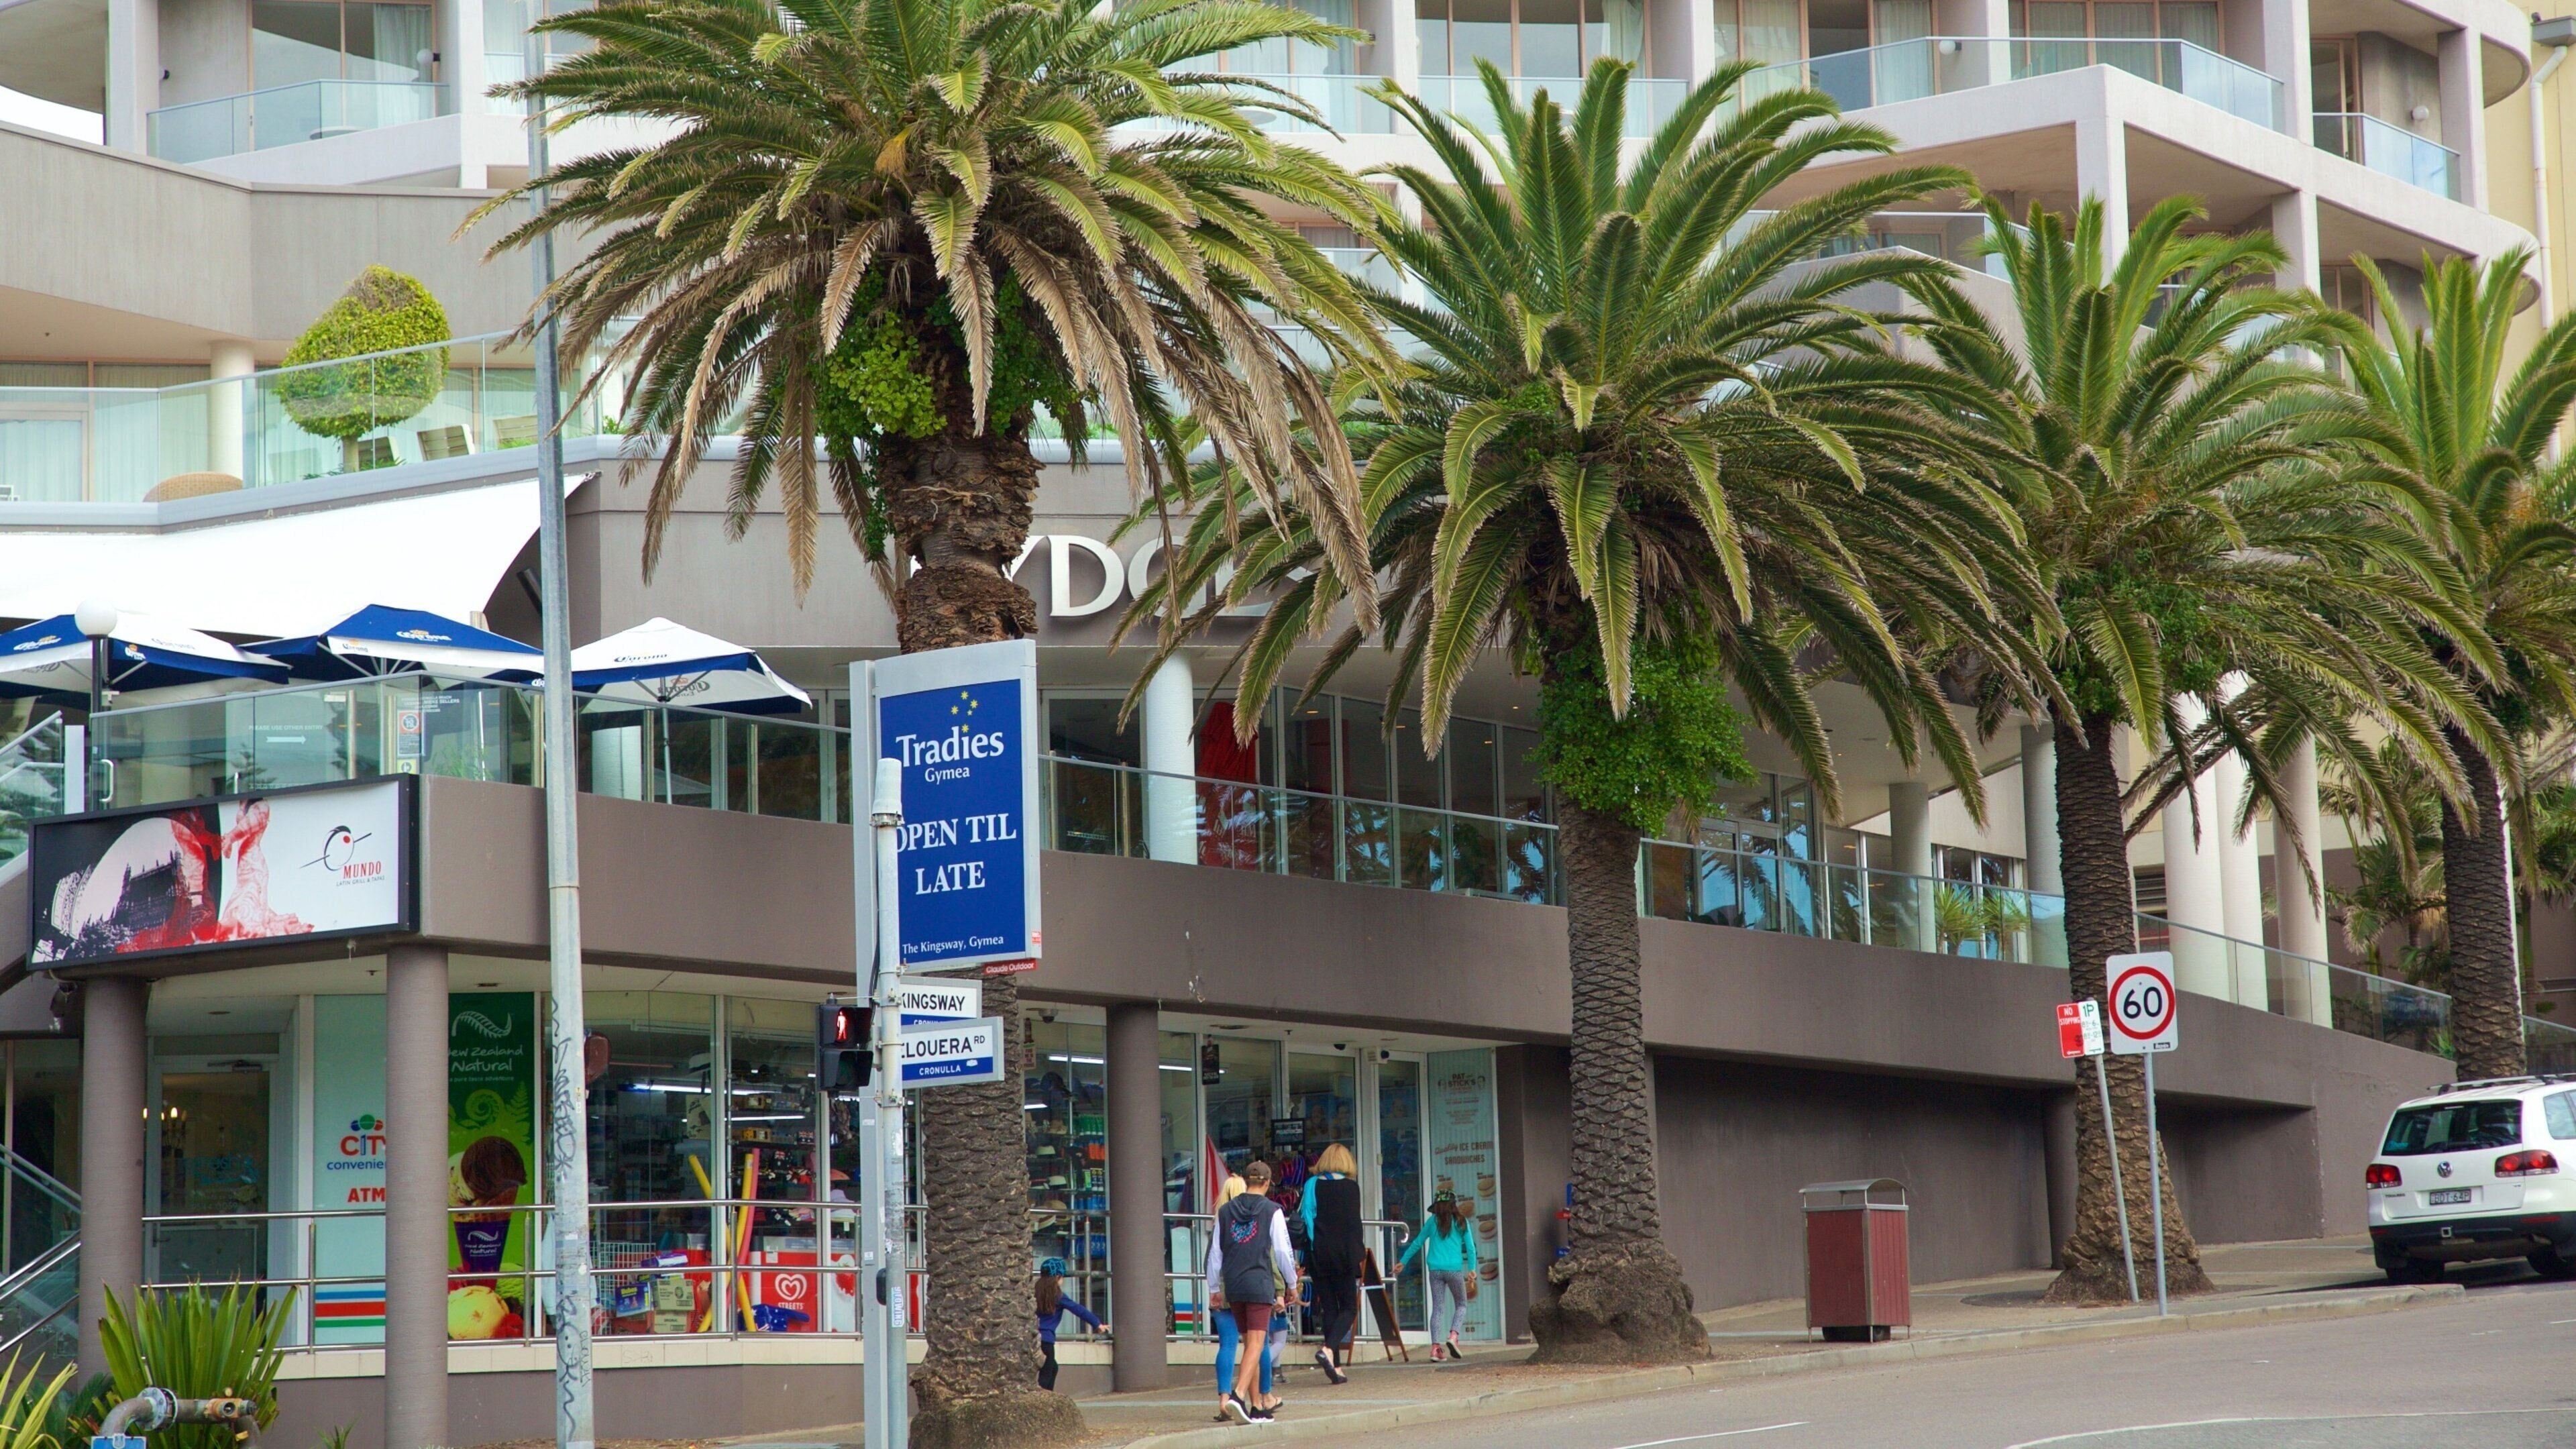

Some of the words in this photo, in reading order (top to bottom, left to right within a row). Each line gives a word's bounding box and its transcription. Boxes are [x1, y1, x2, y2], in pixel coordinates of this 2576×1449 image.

[614, 653, 667, 663] Corona
[896, 726, 1004, 767] Tradies
[924, 767, 970, 785] Gymea
[965, 813, 1017, 843] TIL
[343, 861, 381, 879] MUNDO
[915, 861, 985, 895] LATE
[902, 943, 918, 954] The
[920, 940, 967, 953] Kingsway,
[969, 936, 1004, 949] Gymea
[985, 965, 1008, 974] Claude
[1009, 962, 1034, 971] Outdoor
[2123, 986, 2163, 1019] 60
[2063, 1007, 2073, 1016] NO
[2082, 1004, 2094, 1017] 1P
[471, 1044, 523, 1057] Zealand
[902, 1036, 973, 1059] LOUERA
[974, 1035, 985, 1044] RD
[451, 1058, 513, 1073] Natural
[919, 1065, 961, 1075] CRONULLA
[1459, 1142, 1469, 1151] ICE
[1470, 1141, 1495, 1150] CREAM
[327, 1159, 386, 1171] convenie
[1444, 1155, 1485, 1165] SANDWICHES
[347, 1187, 386, 1203] ATM
